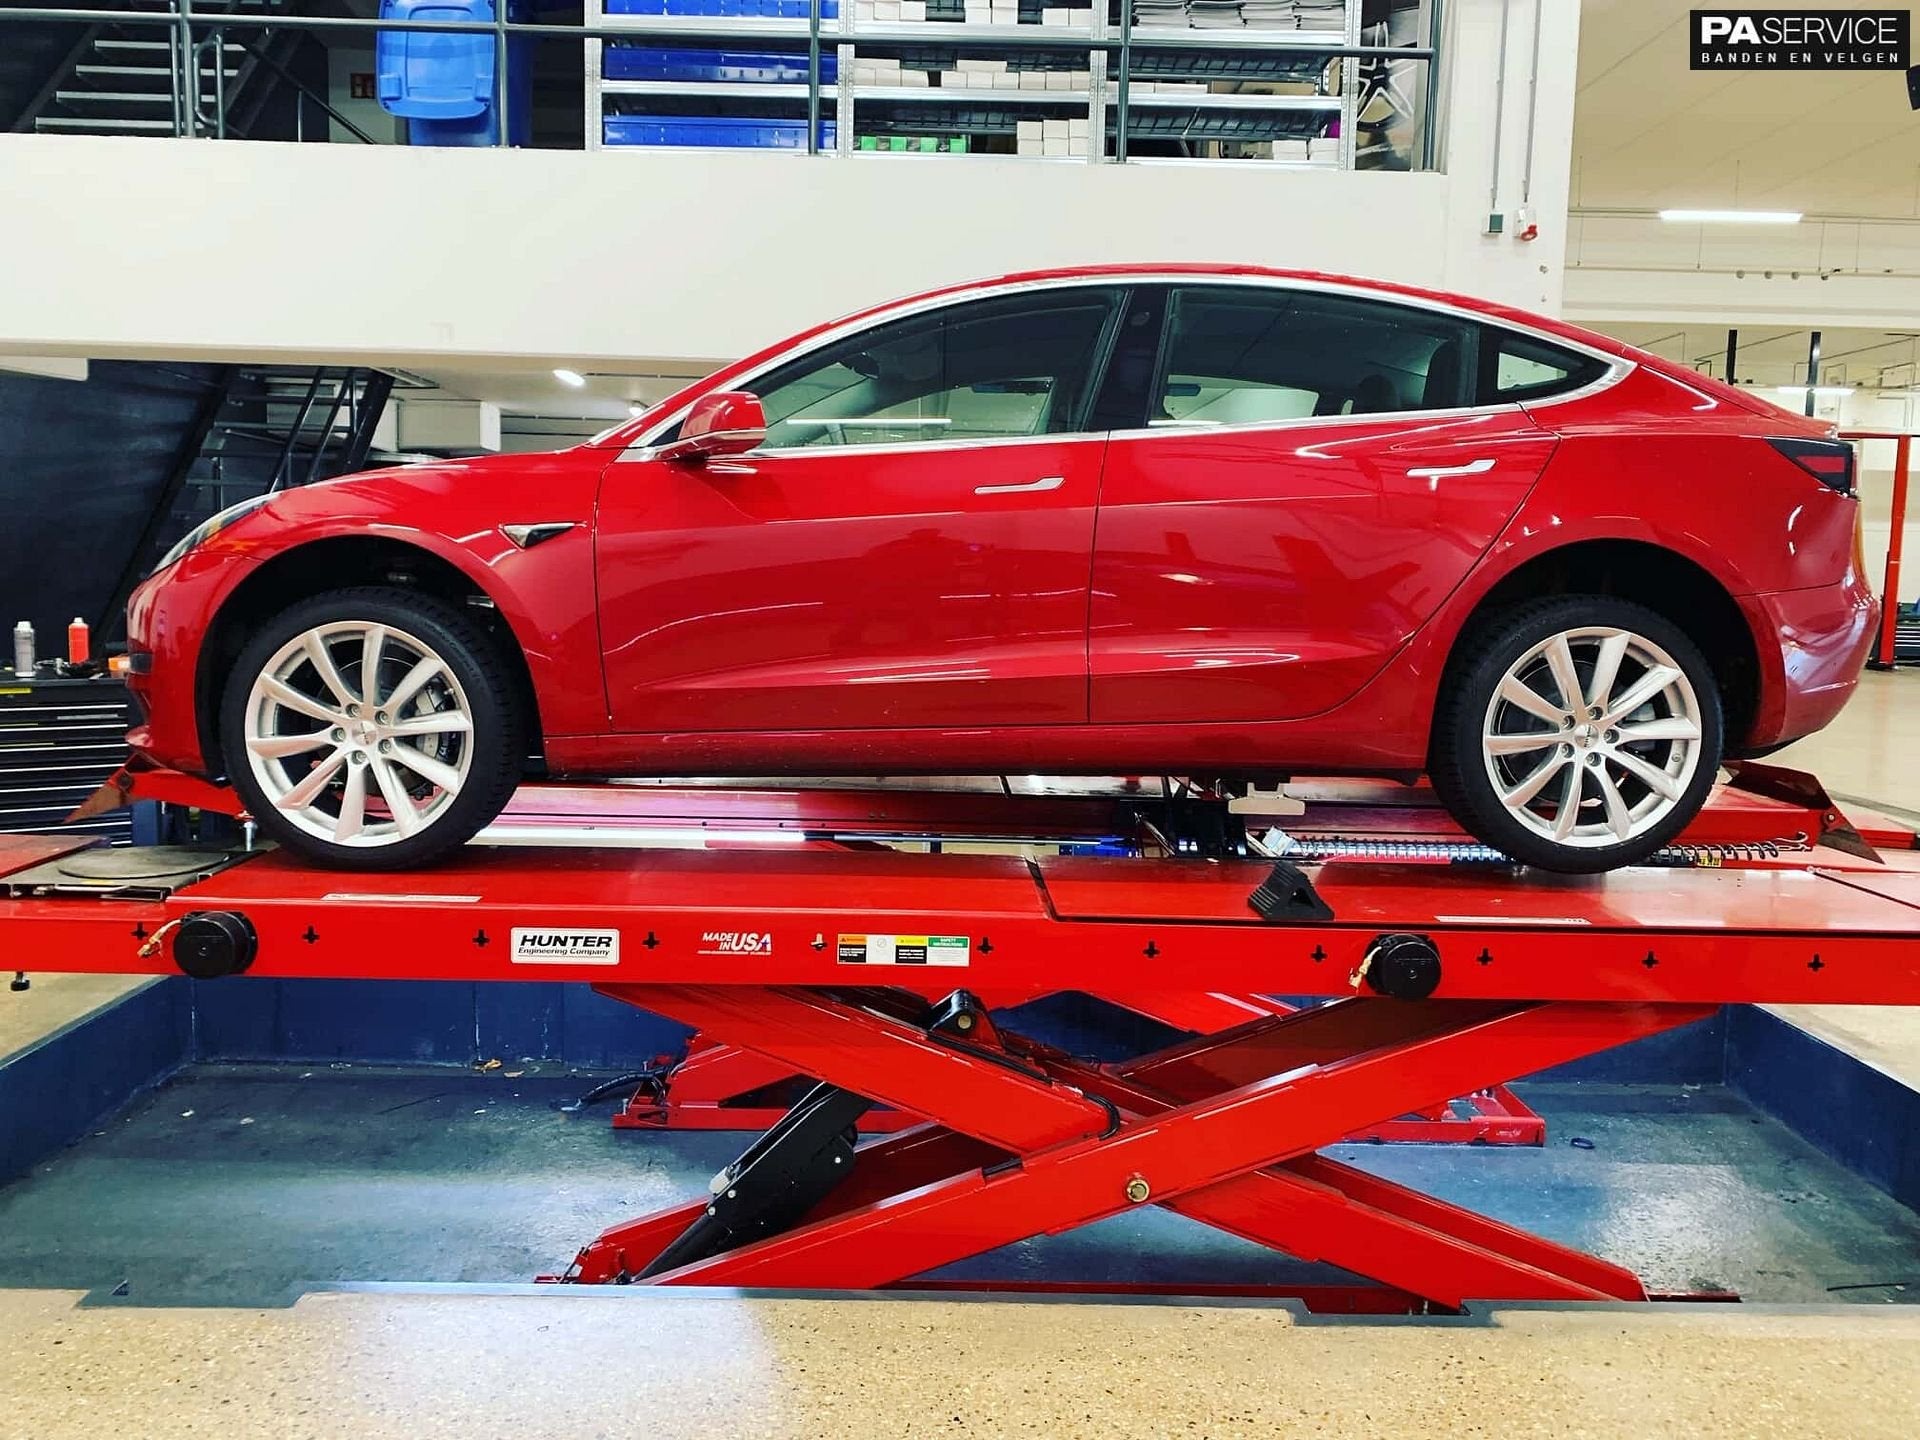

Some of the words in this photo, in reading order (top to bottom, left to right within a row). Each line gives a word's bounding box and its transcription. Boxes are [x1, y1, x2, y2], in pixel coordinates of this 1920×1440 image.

[520, 935, 612, 947] HUNTER
[702, 932, 734, 942] MADE
[719, 941, 731, 951] IN
[731, 933, 771, 951] USA
[518, 947, 567, 956] Engineering
[569, 948, 611, 957] Company
